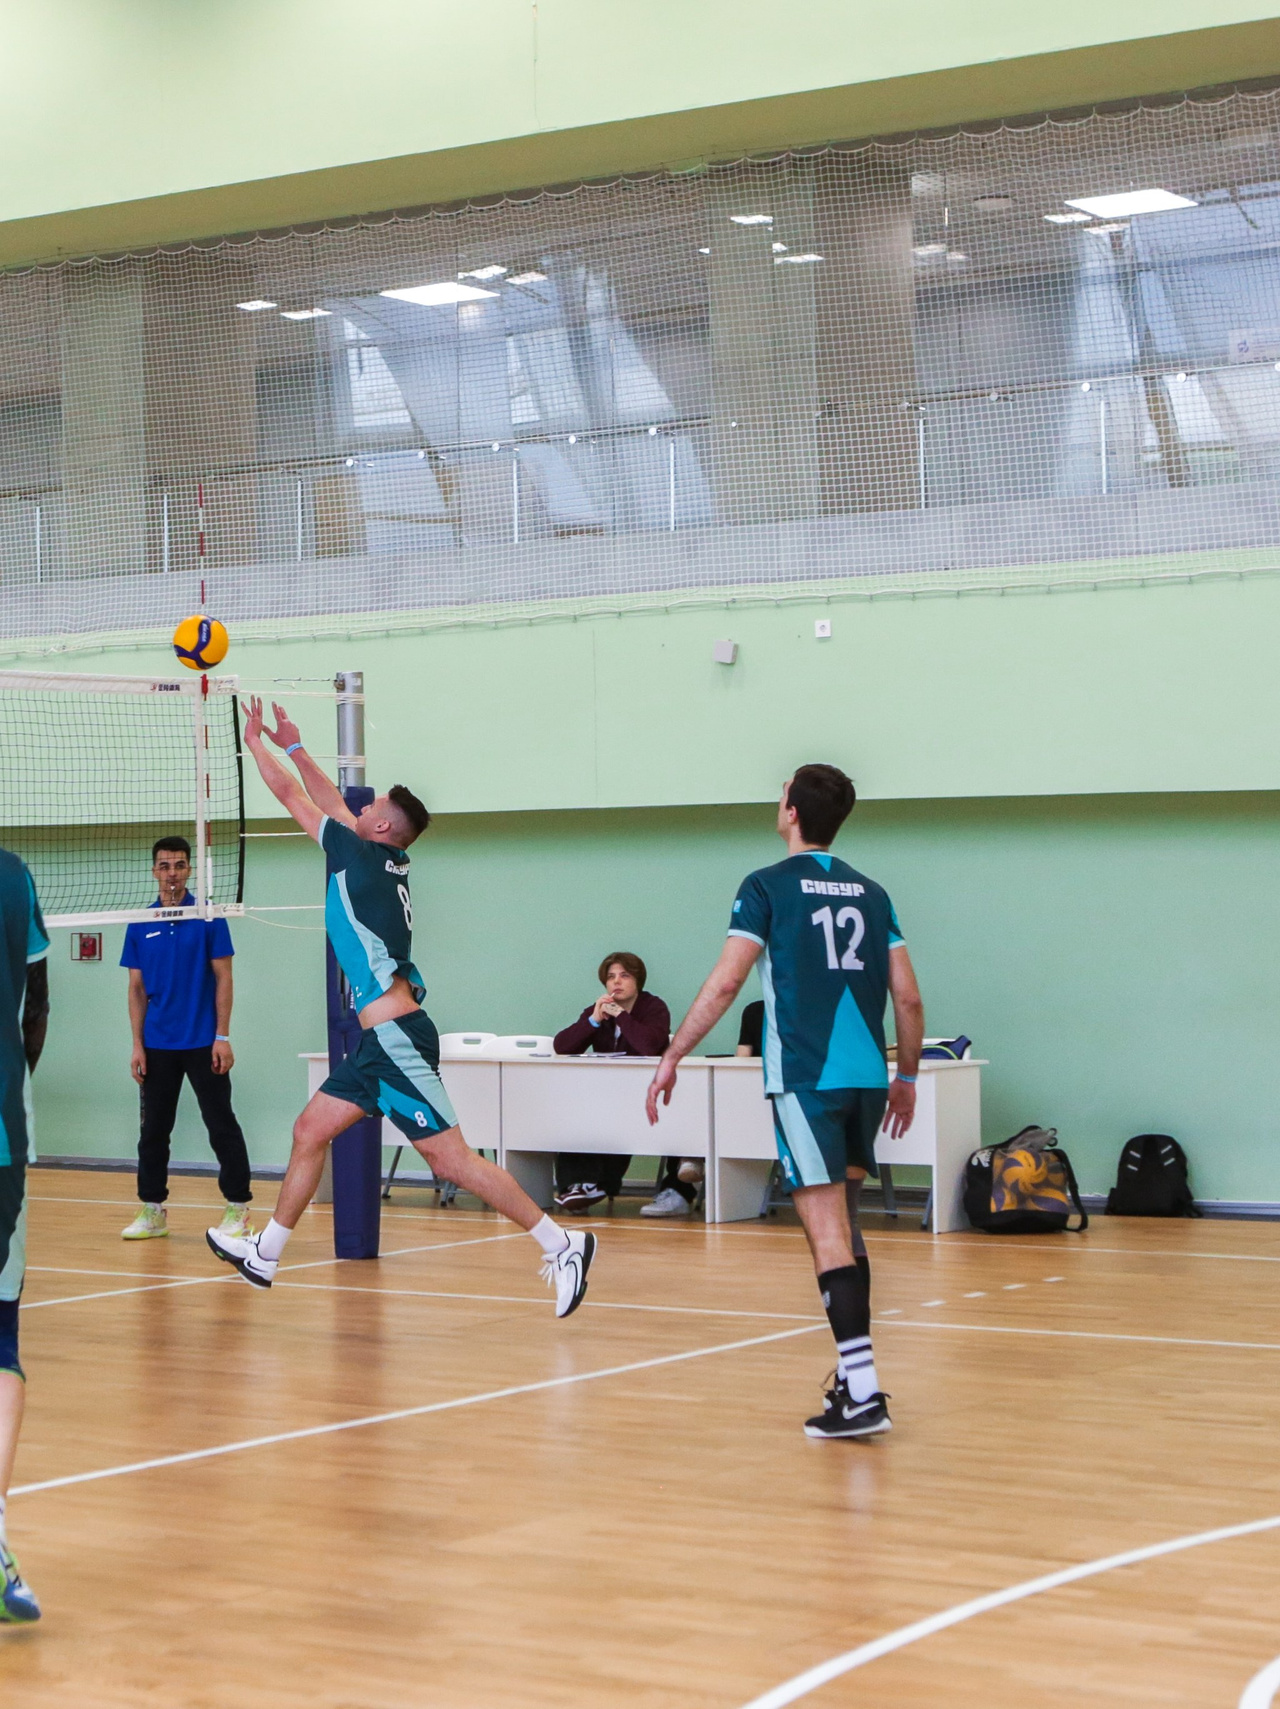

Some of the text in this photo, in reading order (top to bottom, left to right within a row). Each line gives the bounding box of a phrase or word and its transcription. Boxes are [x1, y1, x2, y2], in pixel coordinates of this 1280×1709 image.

[385, 859, 410, 875] СУР
[800, 879, 866, 897] СИБУР
[397, 883, 412, 931] 8
[811, 905, 865, 971] 12
[414, 1110, 428, 1127] 8
